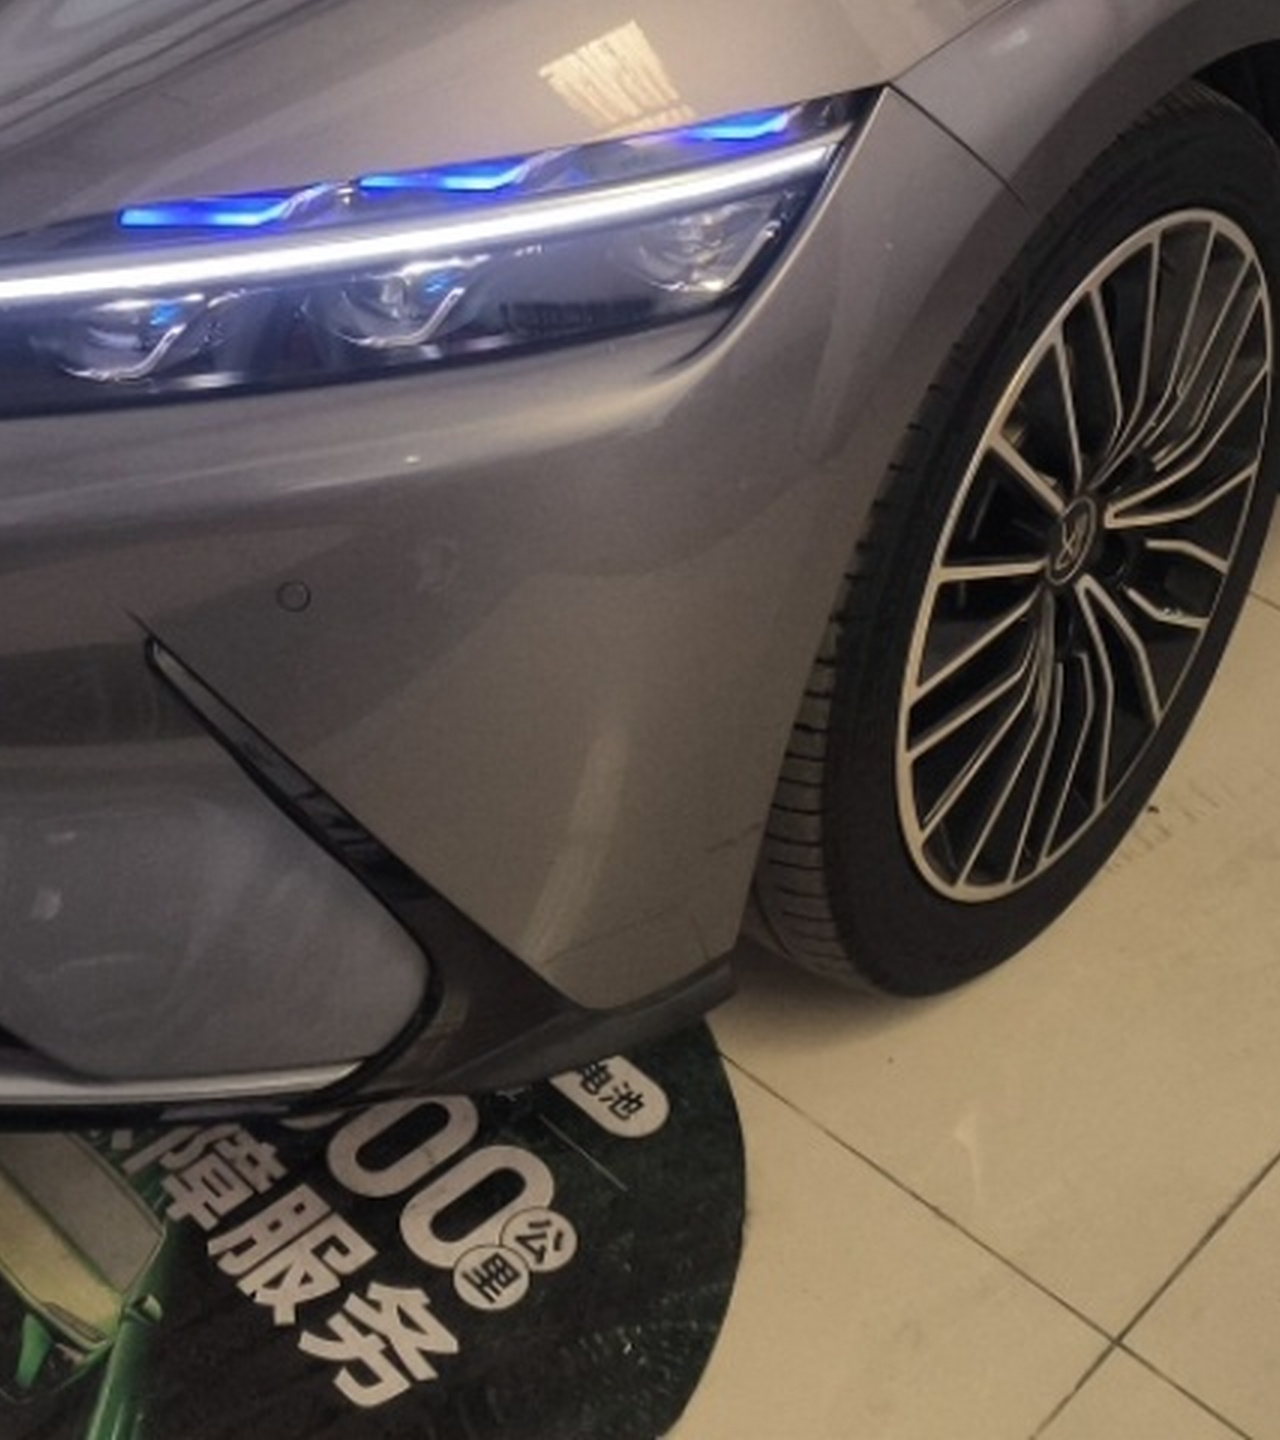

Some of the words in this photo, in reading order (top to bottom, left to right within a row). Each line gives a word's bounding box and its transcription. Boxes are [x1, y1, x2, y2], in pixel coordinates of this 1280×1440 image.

[112, 1124, 460, 1409] 障服务
[278, 1094, 556, 1269] 00
[460, 1217, 565, 1305] 公里
